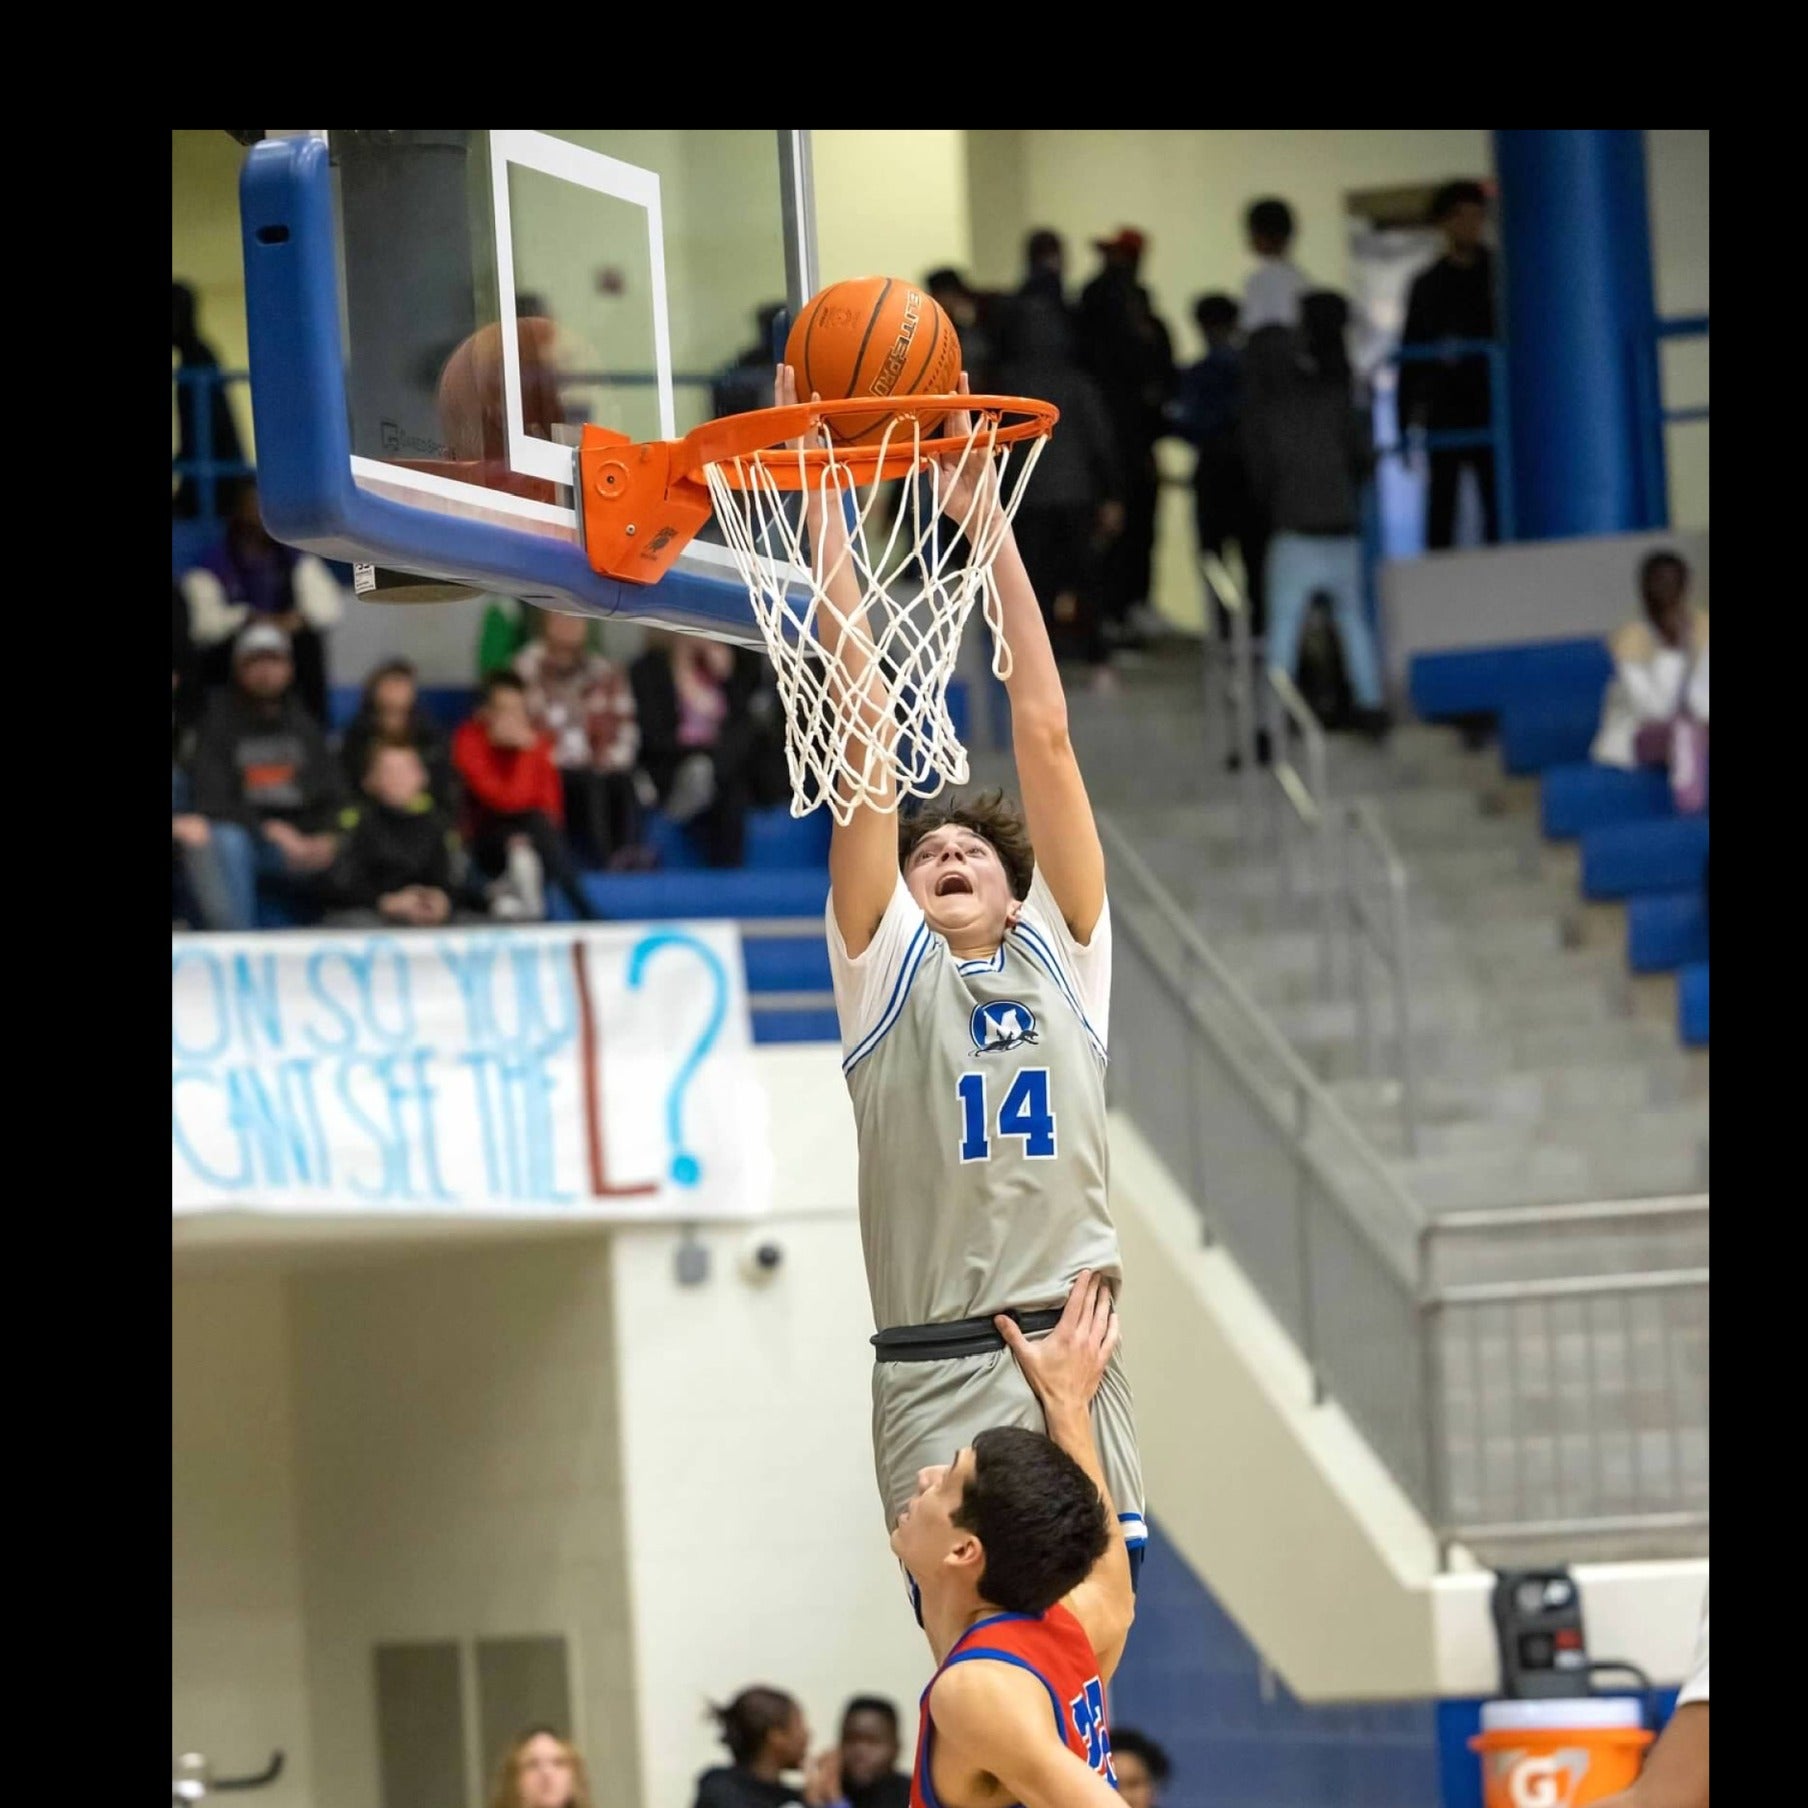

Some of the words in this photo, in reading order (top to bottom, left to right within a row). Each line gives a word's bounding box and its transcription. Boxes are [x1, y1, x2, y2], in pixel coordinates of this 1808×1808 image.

[303, 935, 417, 1053] SO
[436, 931, 578, 1056] YOU
[334, 1045, 464, 1201] SEE
[956, 1066, 1058, 1165] 14
[1510, 1757, 1557, 1808] G
